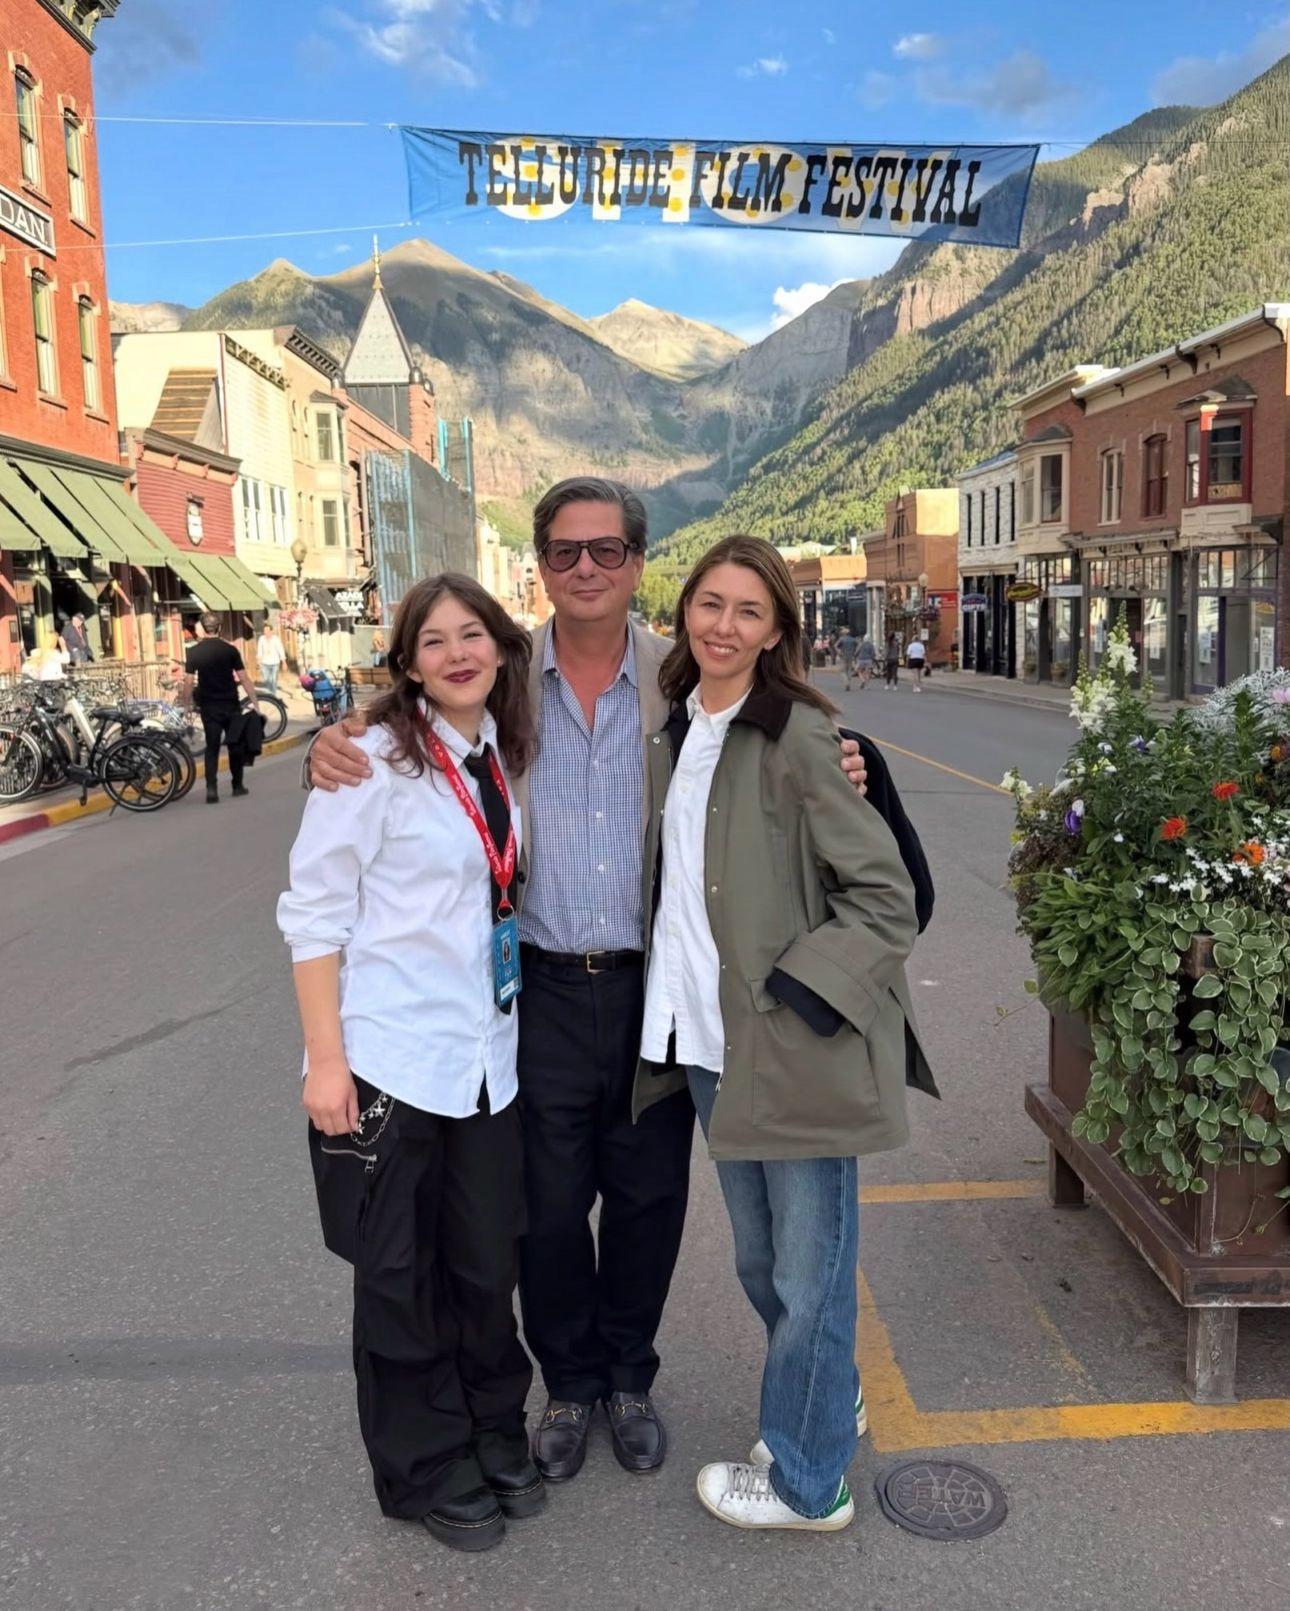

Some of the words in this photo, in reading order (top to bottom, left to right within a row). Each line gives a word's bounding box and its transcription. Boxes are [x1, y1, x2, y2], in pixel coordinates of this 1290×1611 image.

[459, 141, 673, 208] TELLURIDE
[689, 150, 792, 212] FILM
[798, 154, 982, 226] FESTIVAL
